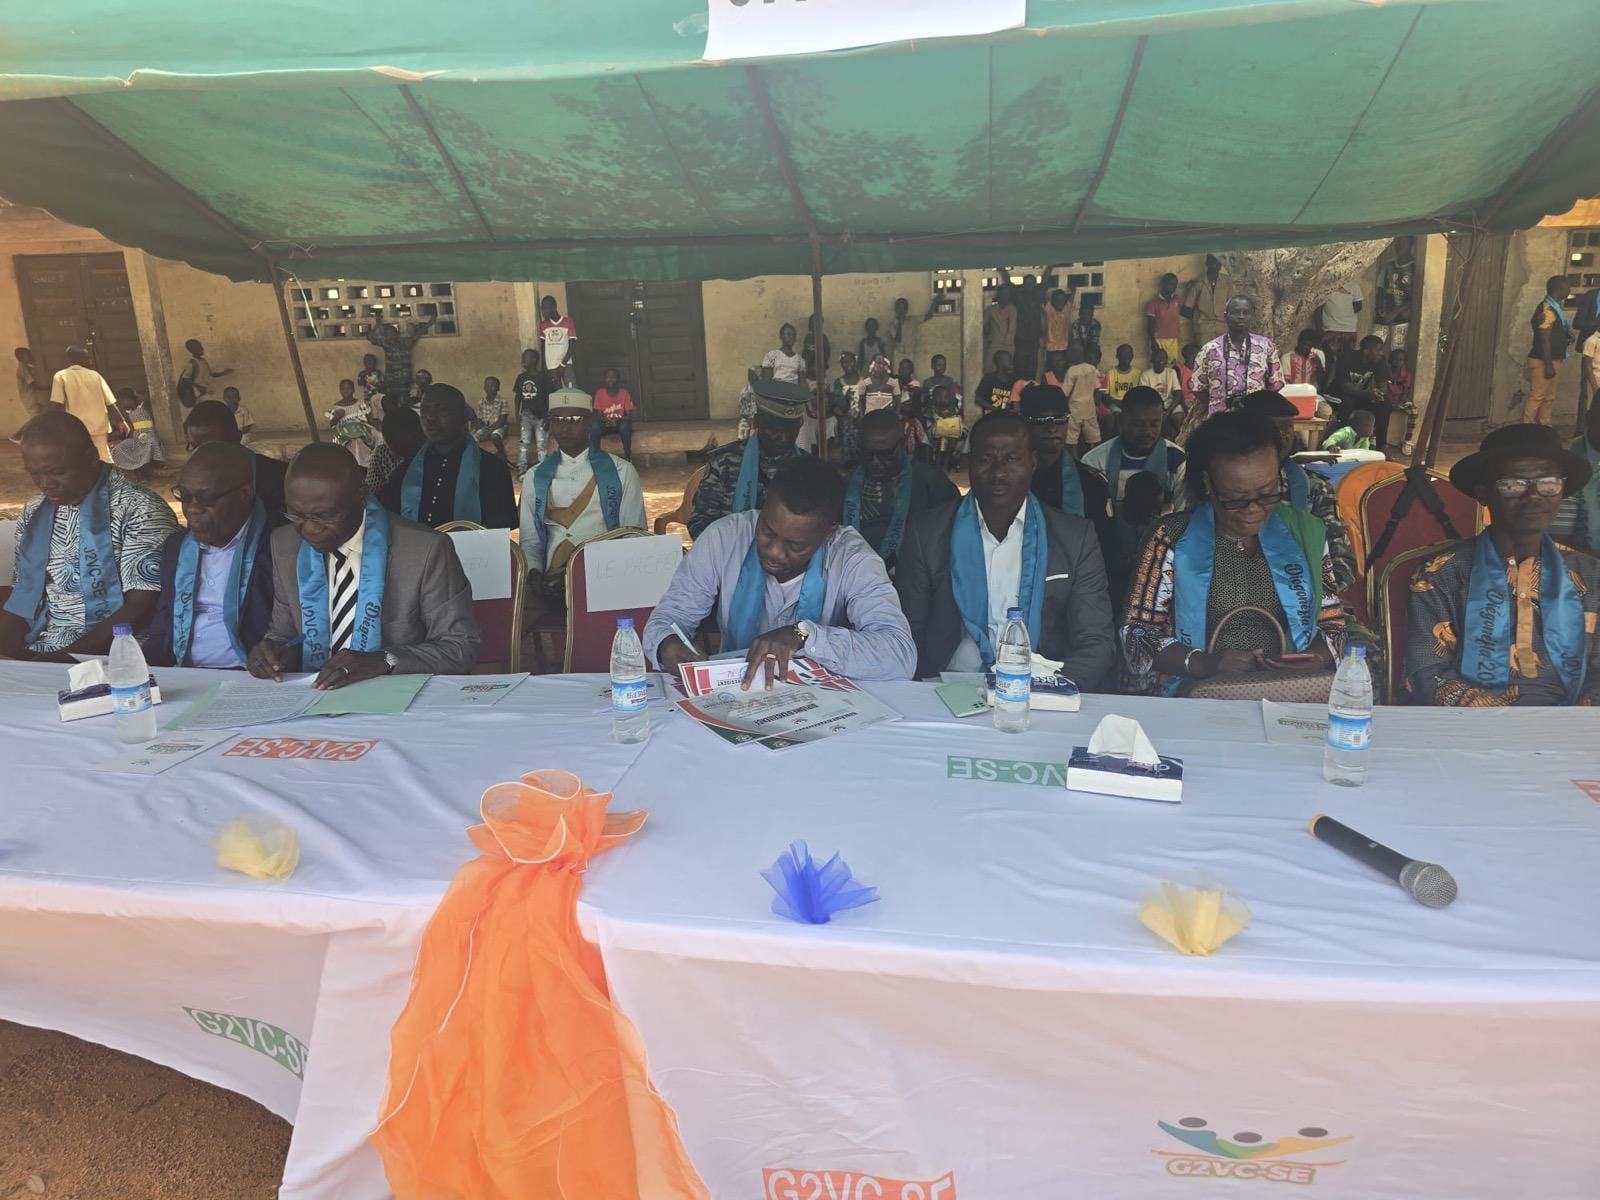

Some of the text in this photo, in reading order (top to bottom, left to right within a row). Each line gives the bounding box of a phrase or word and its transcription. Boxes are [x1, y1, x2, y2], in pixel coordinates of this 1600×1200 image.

[226, 738, 372, 761] G2VC-SE
[951, 757, 1065, 787] VC-SE
[1167, 1158, 1314, 1185] G2VC-SE
